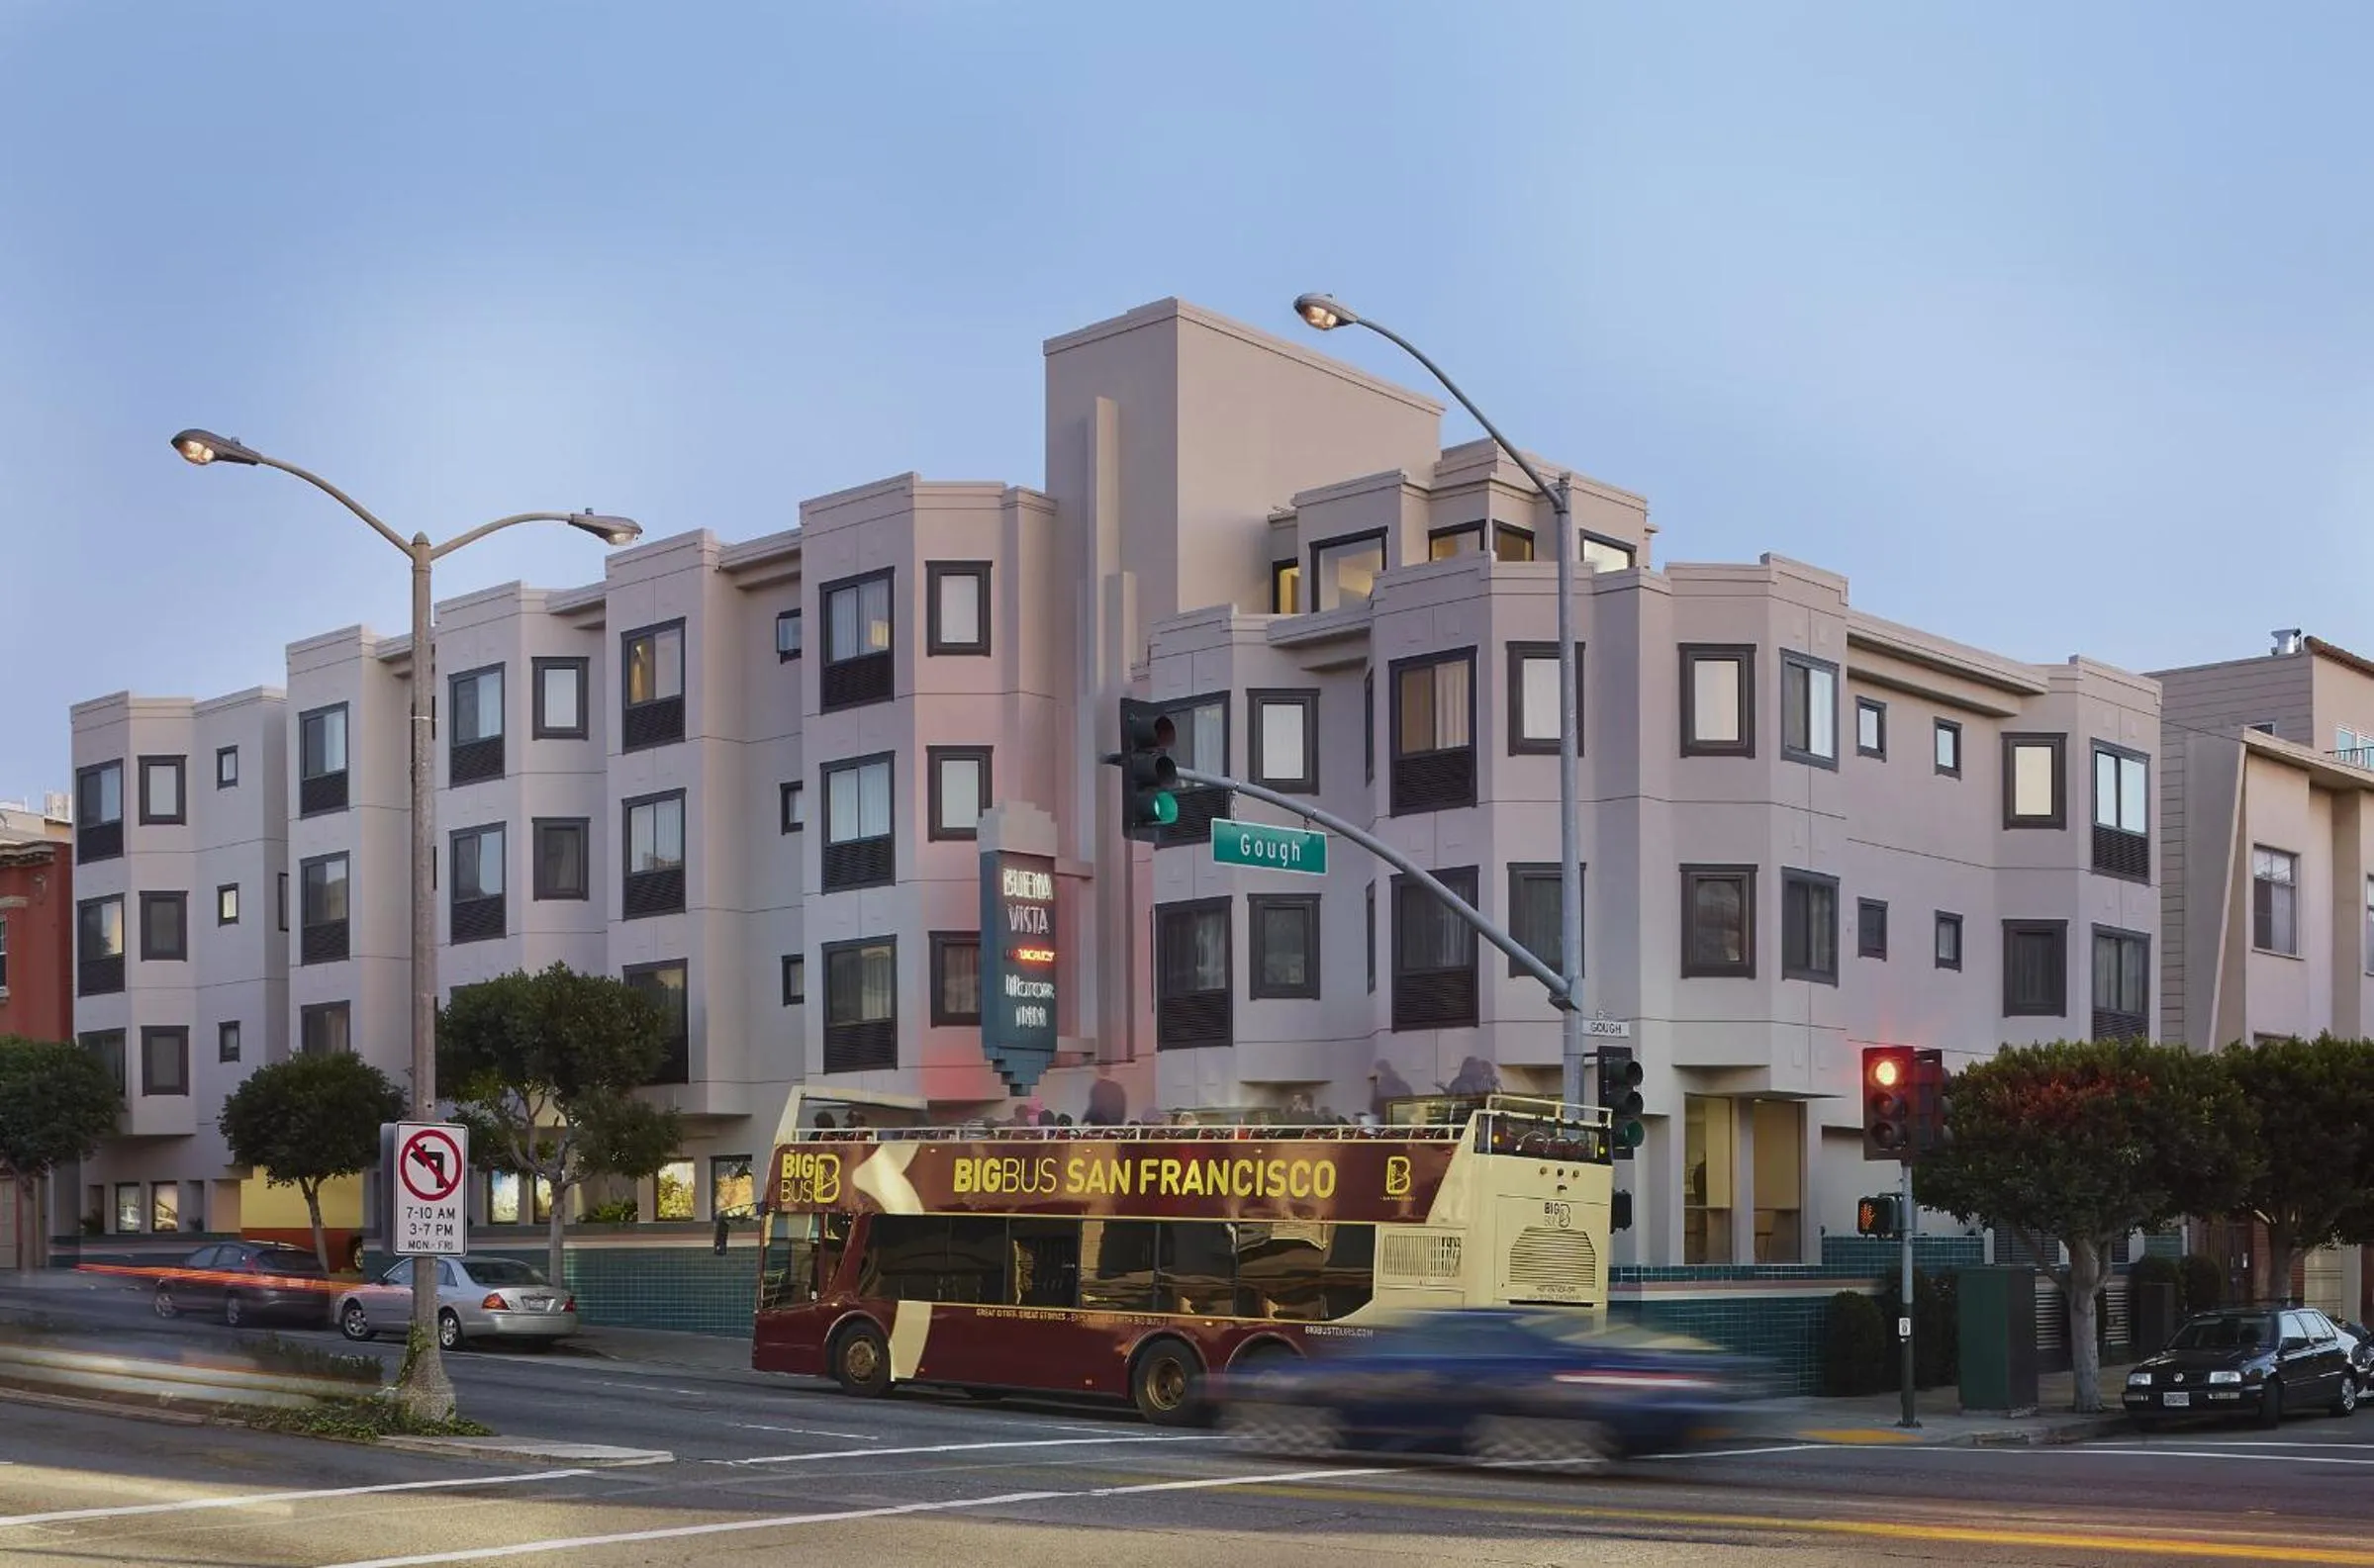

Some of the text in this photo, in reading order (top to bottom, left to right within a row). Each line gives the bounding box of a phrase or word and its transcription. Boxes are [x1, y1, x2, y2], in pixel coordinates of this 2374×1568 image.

[1240, 833, 1300, 868] Gough
[1002, 867, 1053, 900] BUENA
[1007, 903, 1051, 935] VISTA
[1590, 1021, 1622, 1034] GOUGH
[782, 1153, 814, 1178] BIG
[1066, 1157, 1131, 1195] SAN
[1139, 1158, 1336, 1198] FRANCISCO
[780, 1179, 813, 1203] BUS
[407, 1207, 455, 1219] 7-10 AM
[409, 1223, 453, 1236] 3-7 PM
